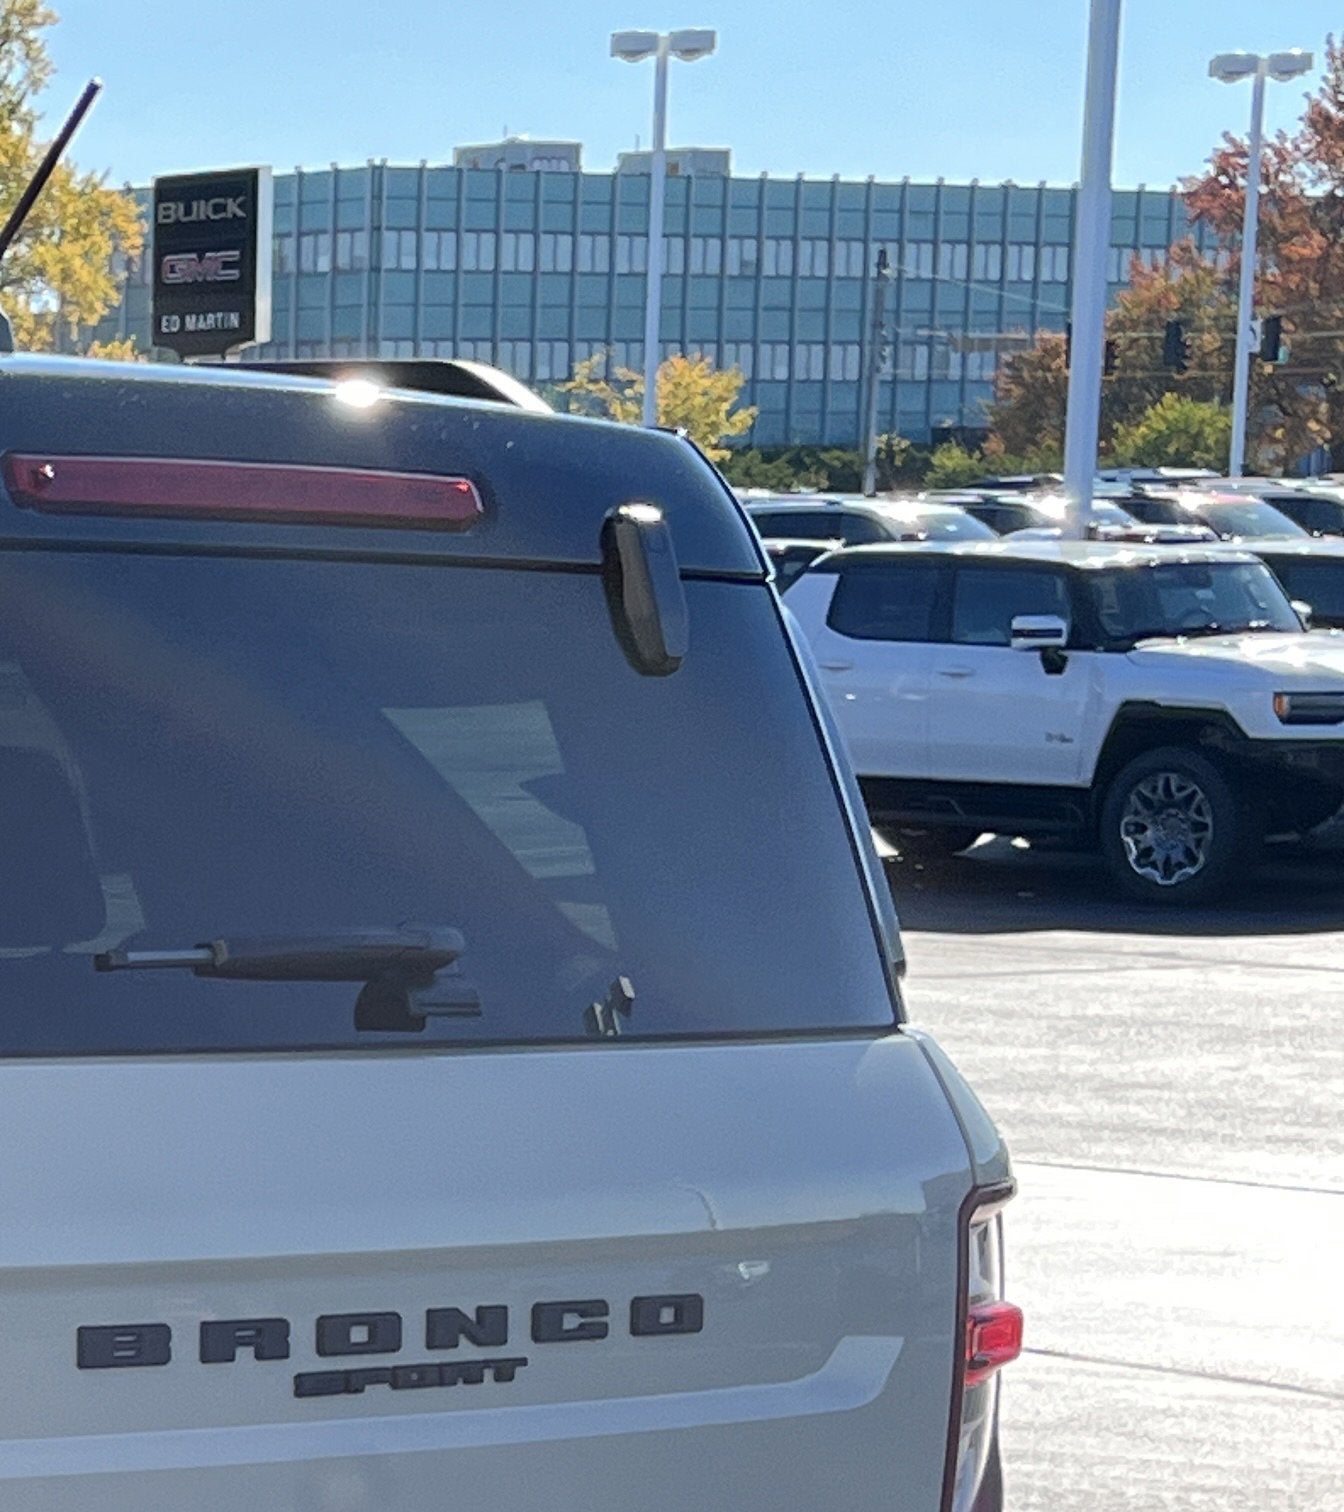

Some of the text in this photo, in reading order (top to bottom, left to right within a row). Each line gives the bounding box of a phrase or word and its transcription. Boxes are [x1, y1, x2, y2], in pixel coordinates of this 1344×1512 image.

[157, 196, 247, 224] BUICK
[163, 250, 240, 284] GMC
[161, 312, 240, 333] ED MARTIN
[76, 1293, 705, 1370] BRONCO
[293, 1356, 528, 1398] SPORT
